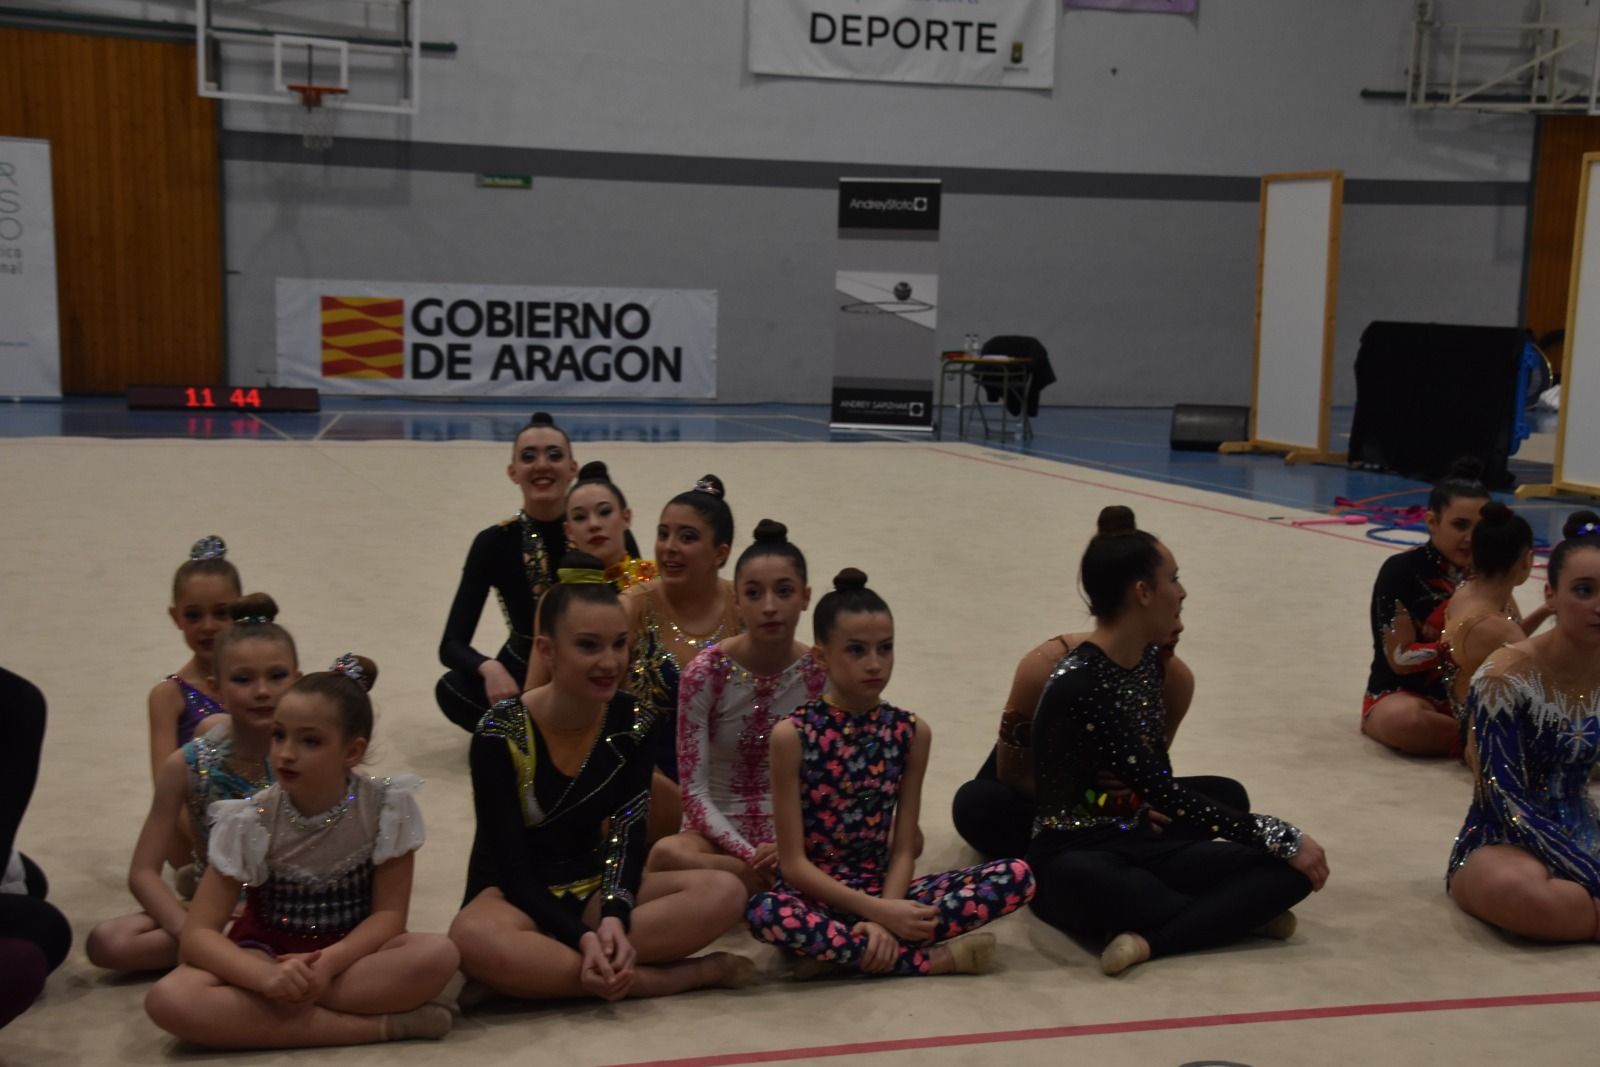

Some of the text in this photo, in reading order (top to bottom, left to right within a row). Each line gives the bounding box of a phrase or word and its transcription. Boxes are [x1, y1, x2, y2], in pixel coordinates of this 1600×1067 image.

[809, 12, 998, 54] DEPORTE
[410, 298, 651, 340] GOBIERNO
[410, 342, 682, 382] DE ARAGON
[185, 387, 262, 407] 11 44
